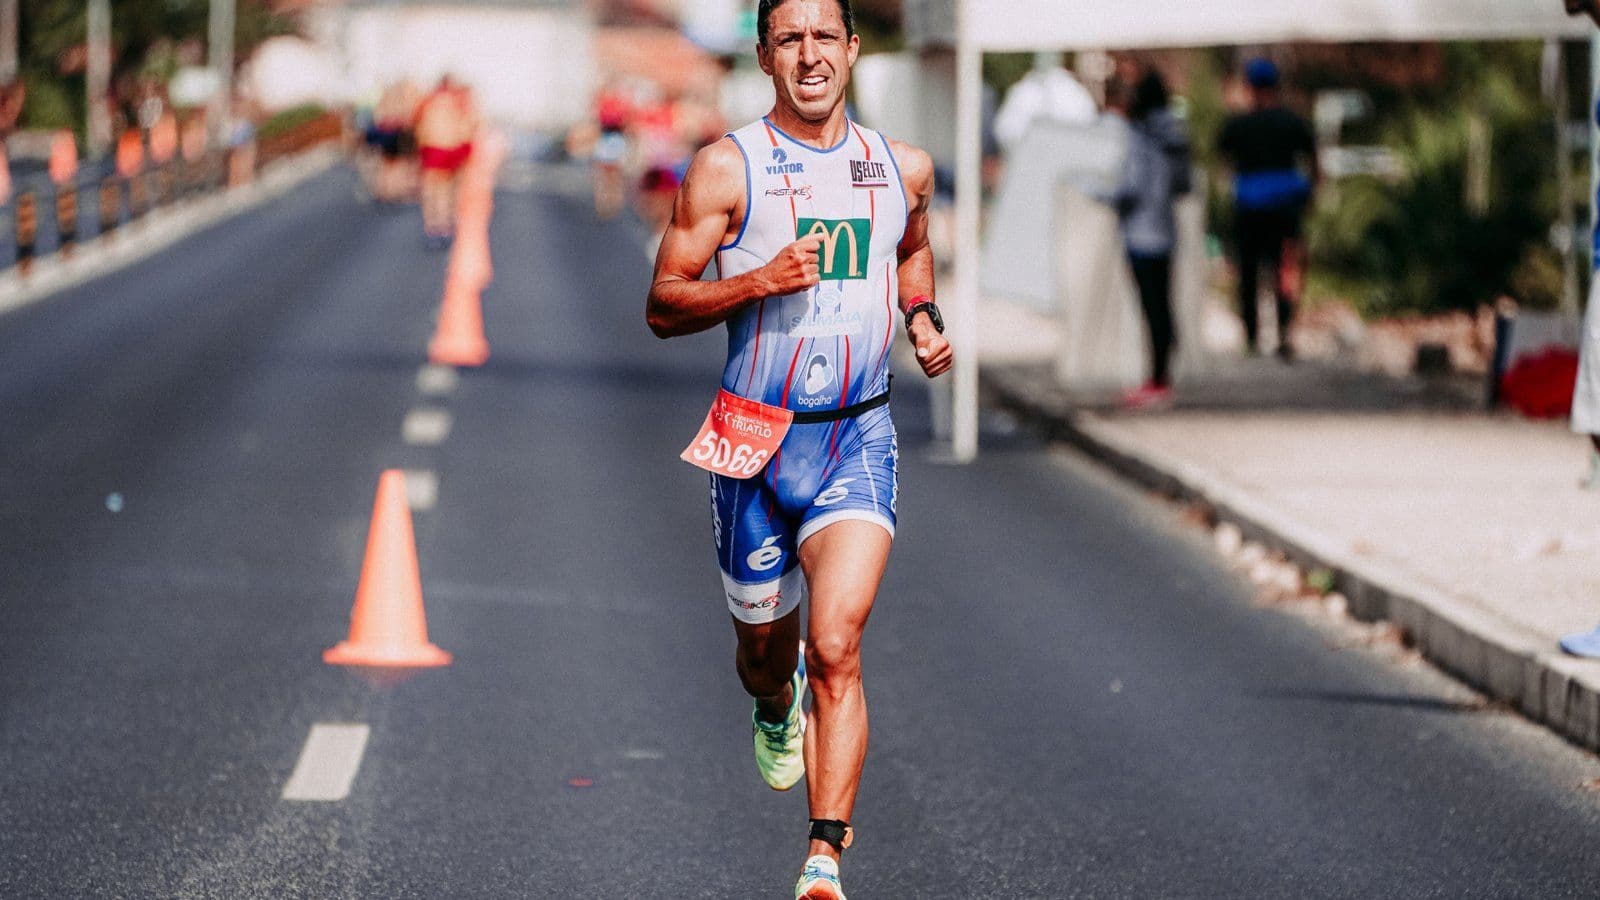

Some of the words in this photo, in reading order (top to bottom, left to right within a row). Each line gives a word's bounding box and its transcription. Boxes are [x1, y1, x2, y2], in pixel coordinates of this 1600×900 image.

[765, 162, 804, 175] VIATOR
[731, 417, 773, 439] TRIATLO
[693, 430, 768, 475] 5066
[746, 535, 783, 571] é
